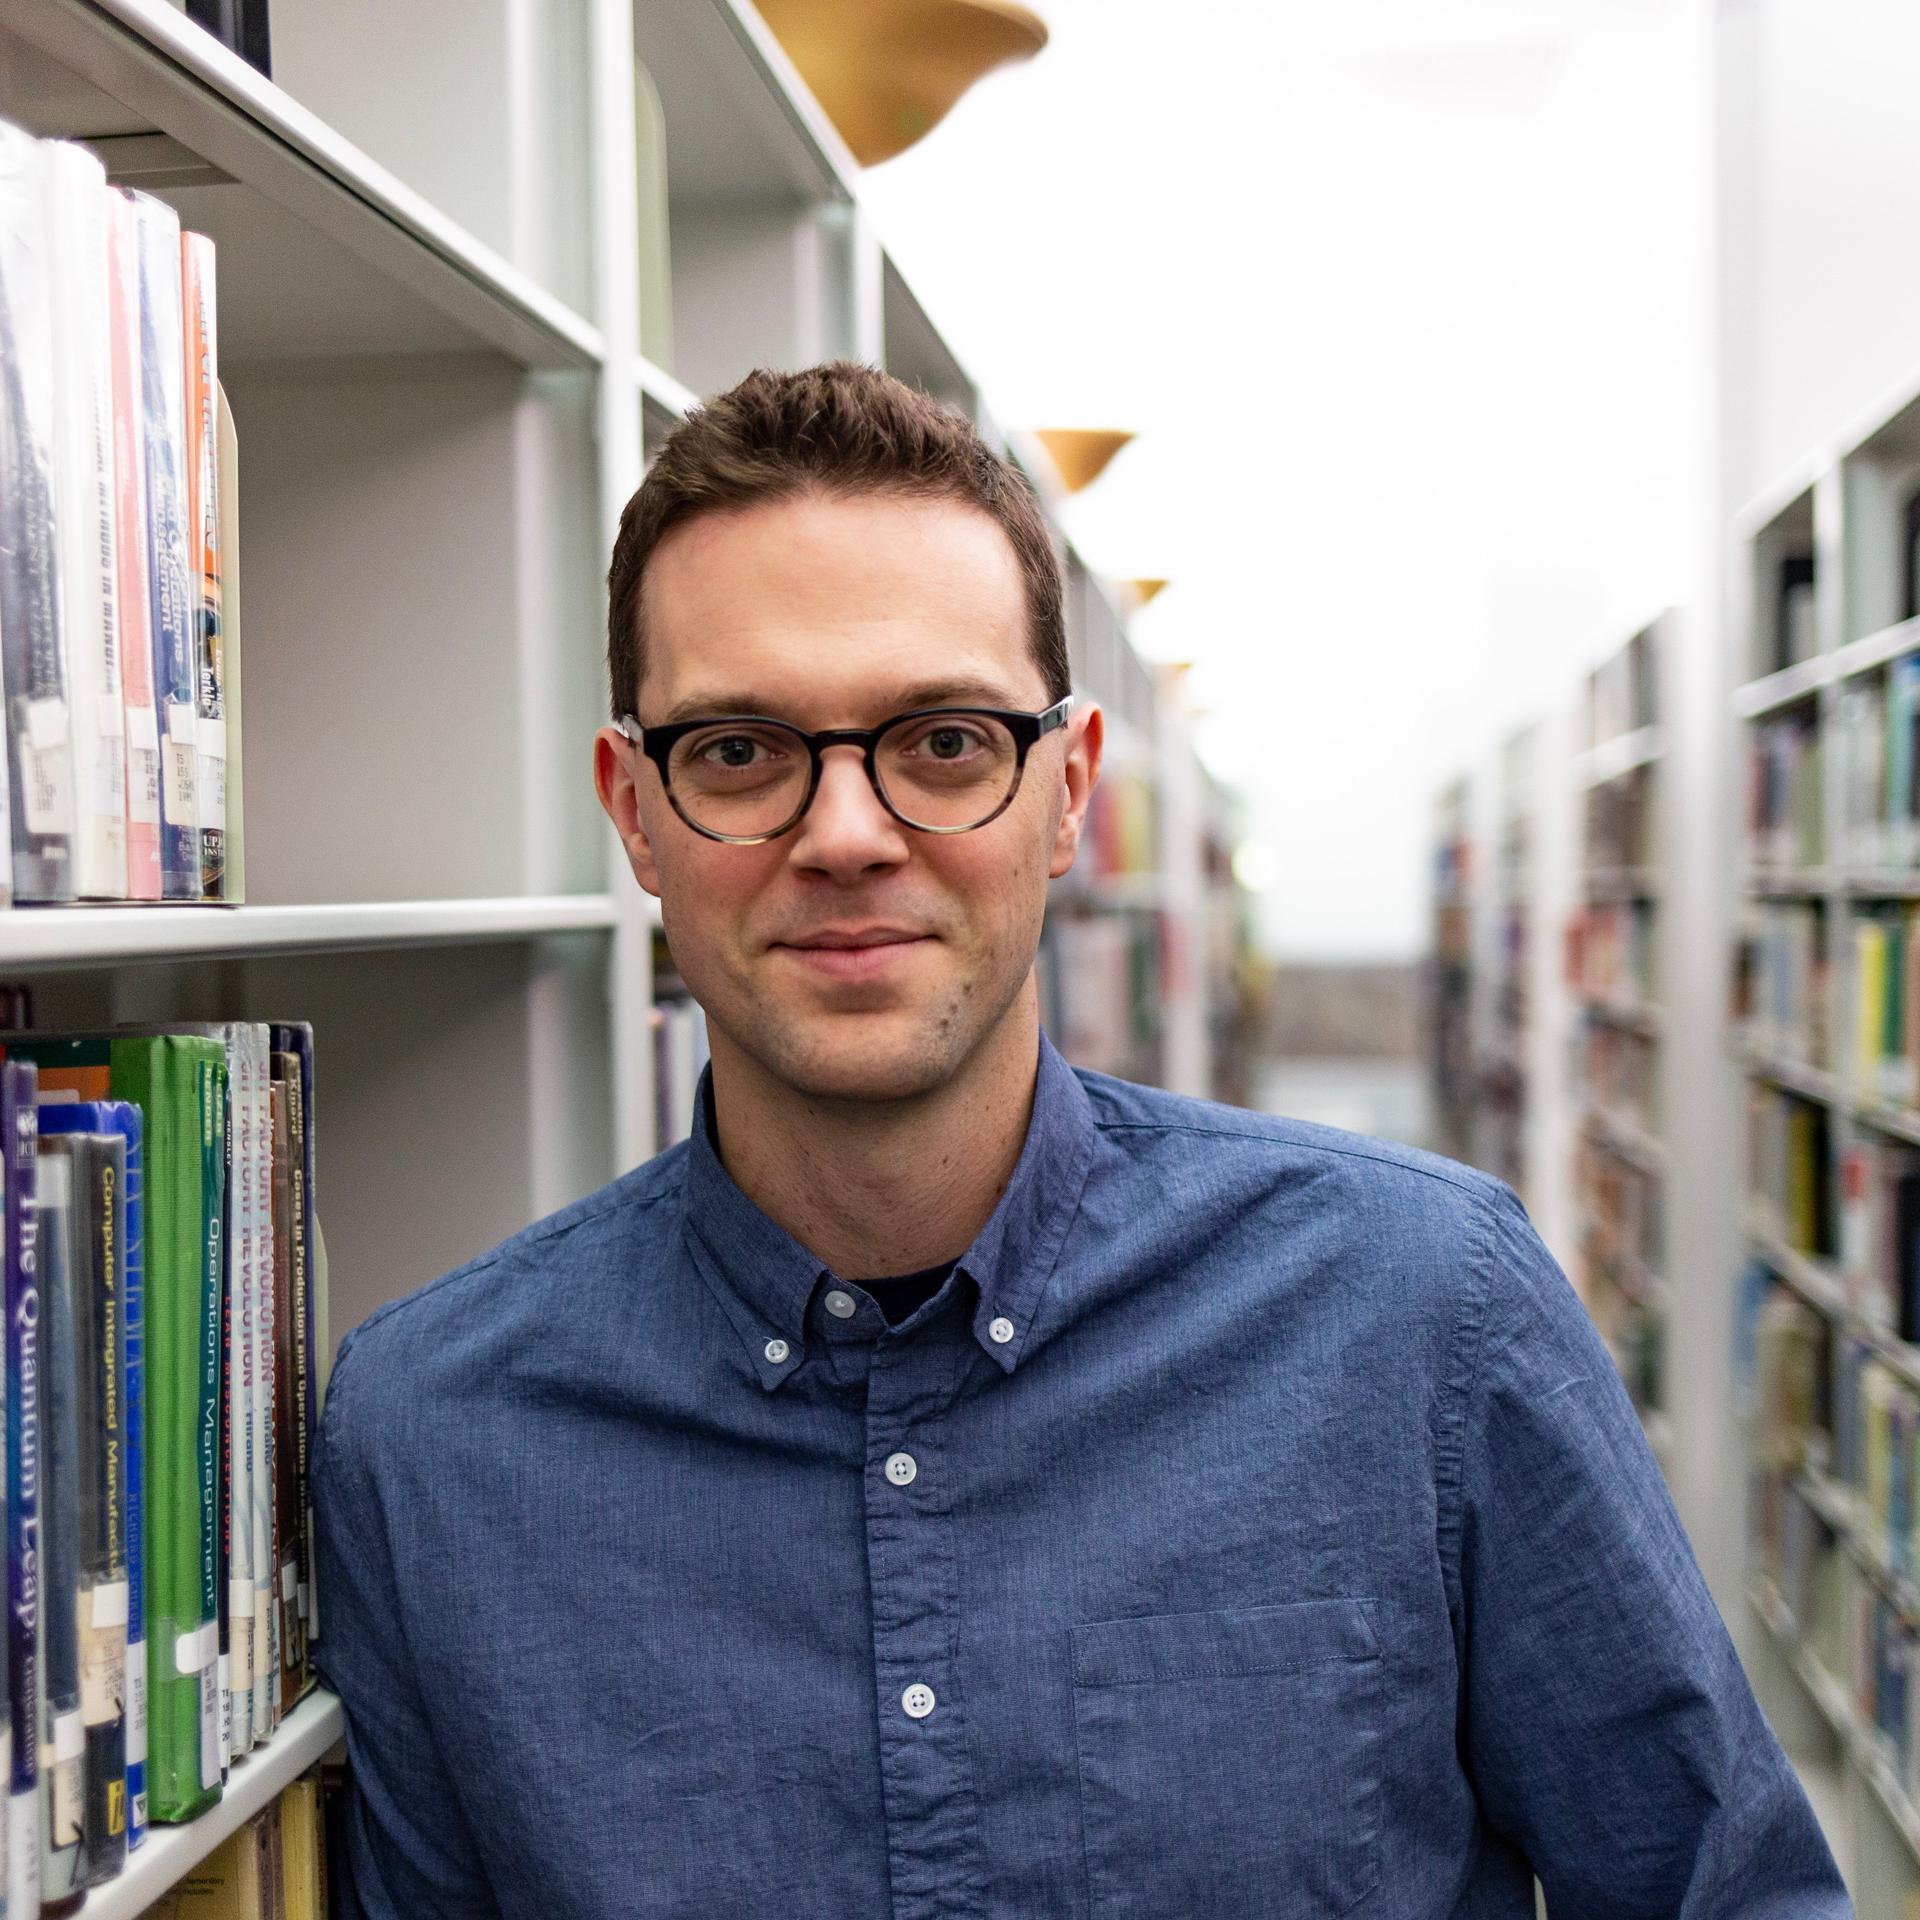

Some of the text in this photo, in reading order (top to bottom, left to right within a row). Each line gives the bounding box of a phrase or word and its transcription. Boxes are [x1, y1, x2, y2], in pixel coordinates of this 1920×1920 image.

[203, 835, 223, 848] UPJ
[204, 1066, 212, 1141] RENDER
[101, 1166, 115, 1291] Computer
[293, 1169, 303, 1220] Cases
[295, 1223, 304, 1241] in
[295, 1245, 305, 1339] Production
[16, 1288, 38, 1499] Quantum
[104, 1300, 117, 1429] Integrated
[297, 1344, 306, 1375] and
[203, 1218, 220, 1607] Operations Management
[296, 1380, 307, 1474] Operations
